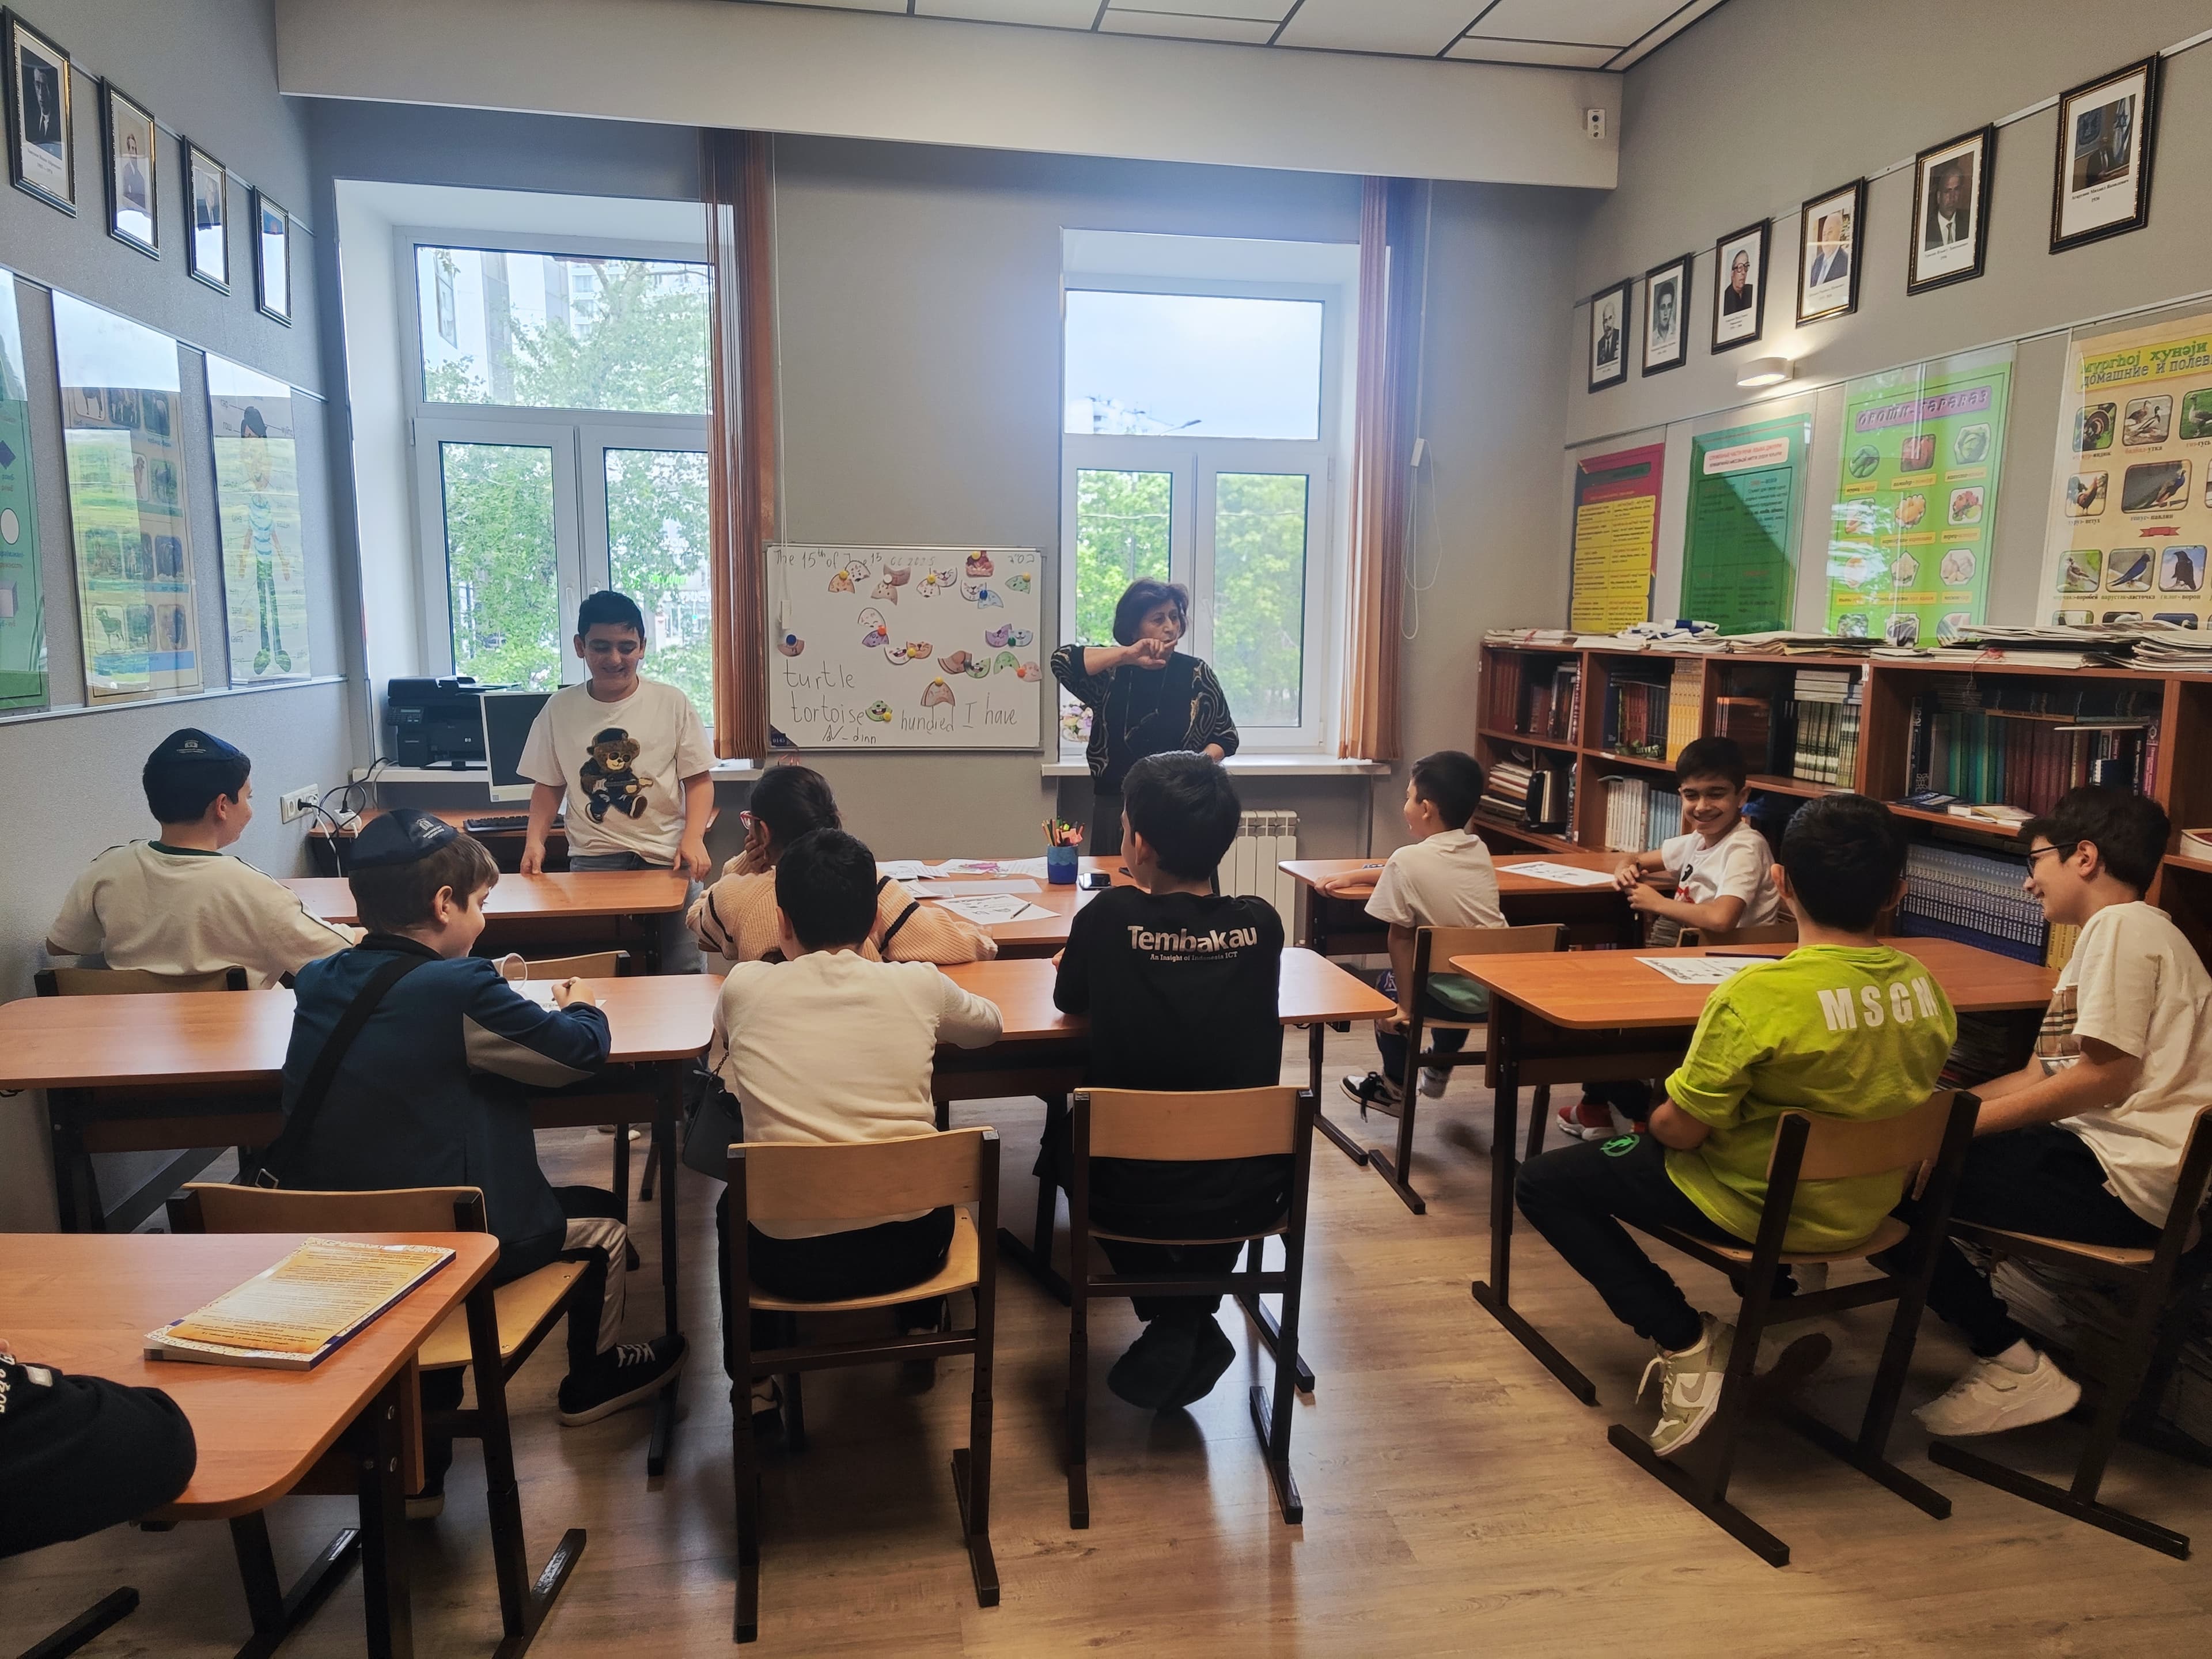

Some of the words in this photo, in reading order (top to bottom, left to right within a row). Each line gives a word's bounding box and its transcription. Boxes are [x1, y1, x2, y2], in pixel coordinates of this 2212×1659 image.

[2081, 365, 2148, 388] домашние
[774, 549, 794, 565] The
[827, 551, 839, 569] of
[783, 659, 855, 690] turtle
[791, 691, 864, 725] tortoise
[985, 692, 1017, 725] have
[1127, 925, 1257, 953] Tembakau
[1160, 954, 1183, 963] Insight
